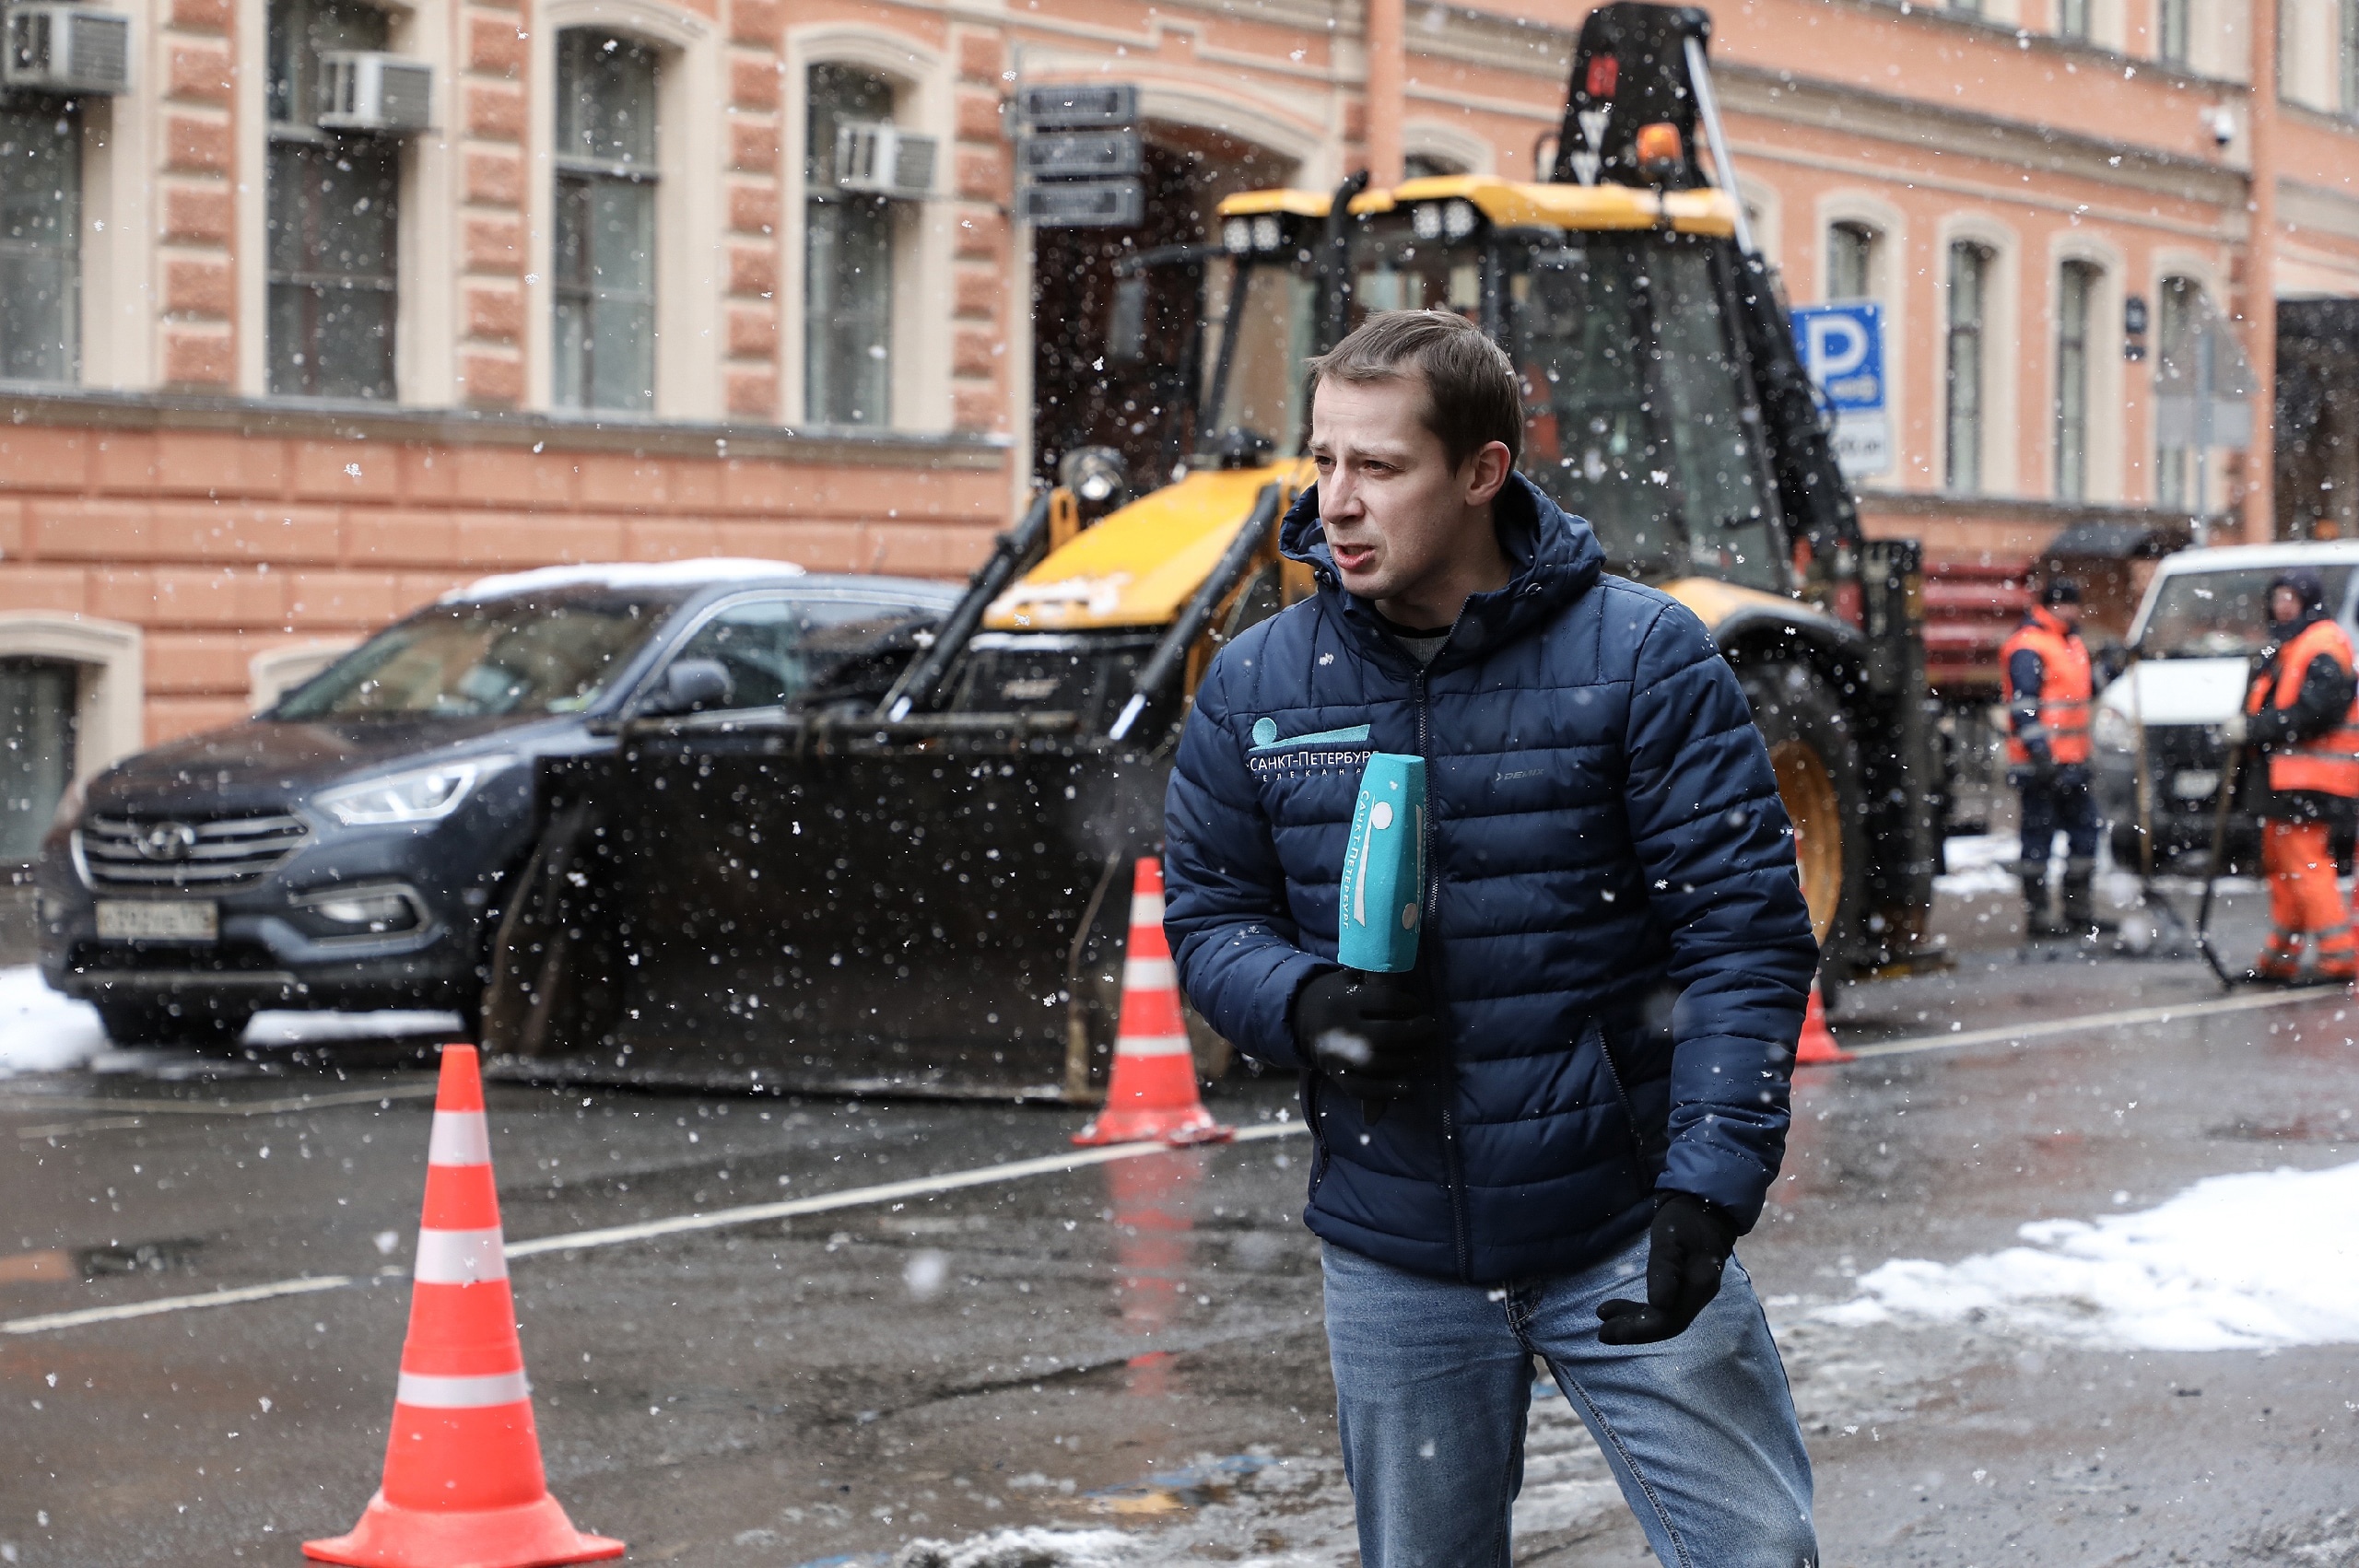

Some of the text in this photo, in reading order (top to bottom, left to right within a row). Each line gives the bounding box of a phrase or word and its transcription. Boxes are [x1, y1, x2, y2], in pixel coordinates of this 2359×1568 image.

[1250, 751, 1379, 771] САНКТ-ПЕТЕРБУР
[1254, 767, 1361, 782] ЕЛЕКАНА
[1504, 768, 1544, 780] DEMIX
[1342, 790, 1370, 930] САНКТ-ПЕТЕРБУРГ
